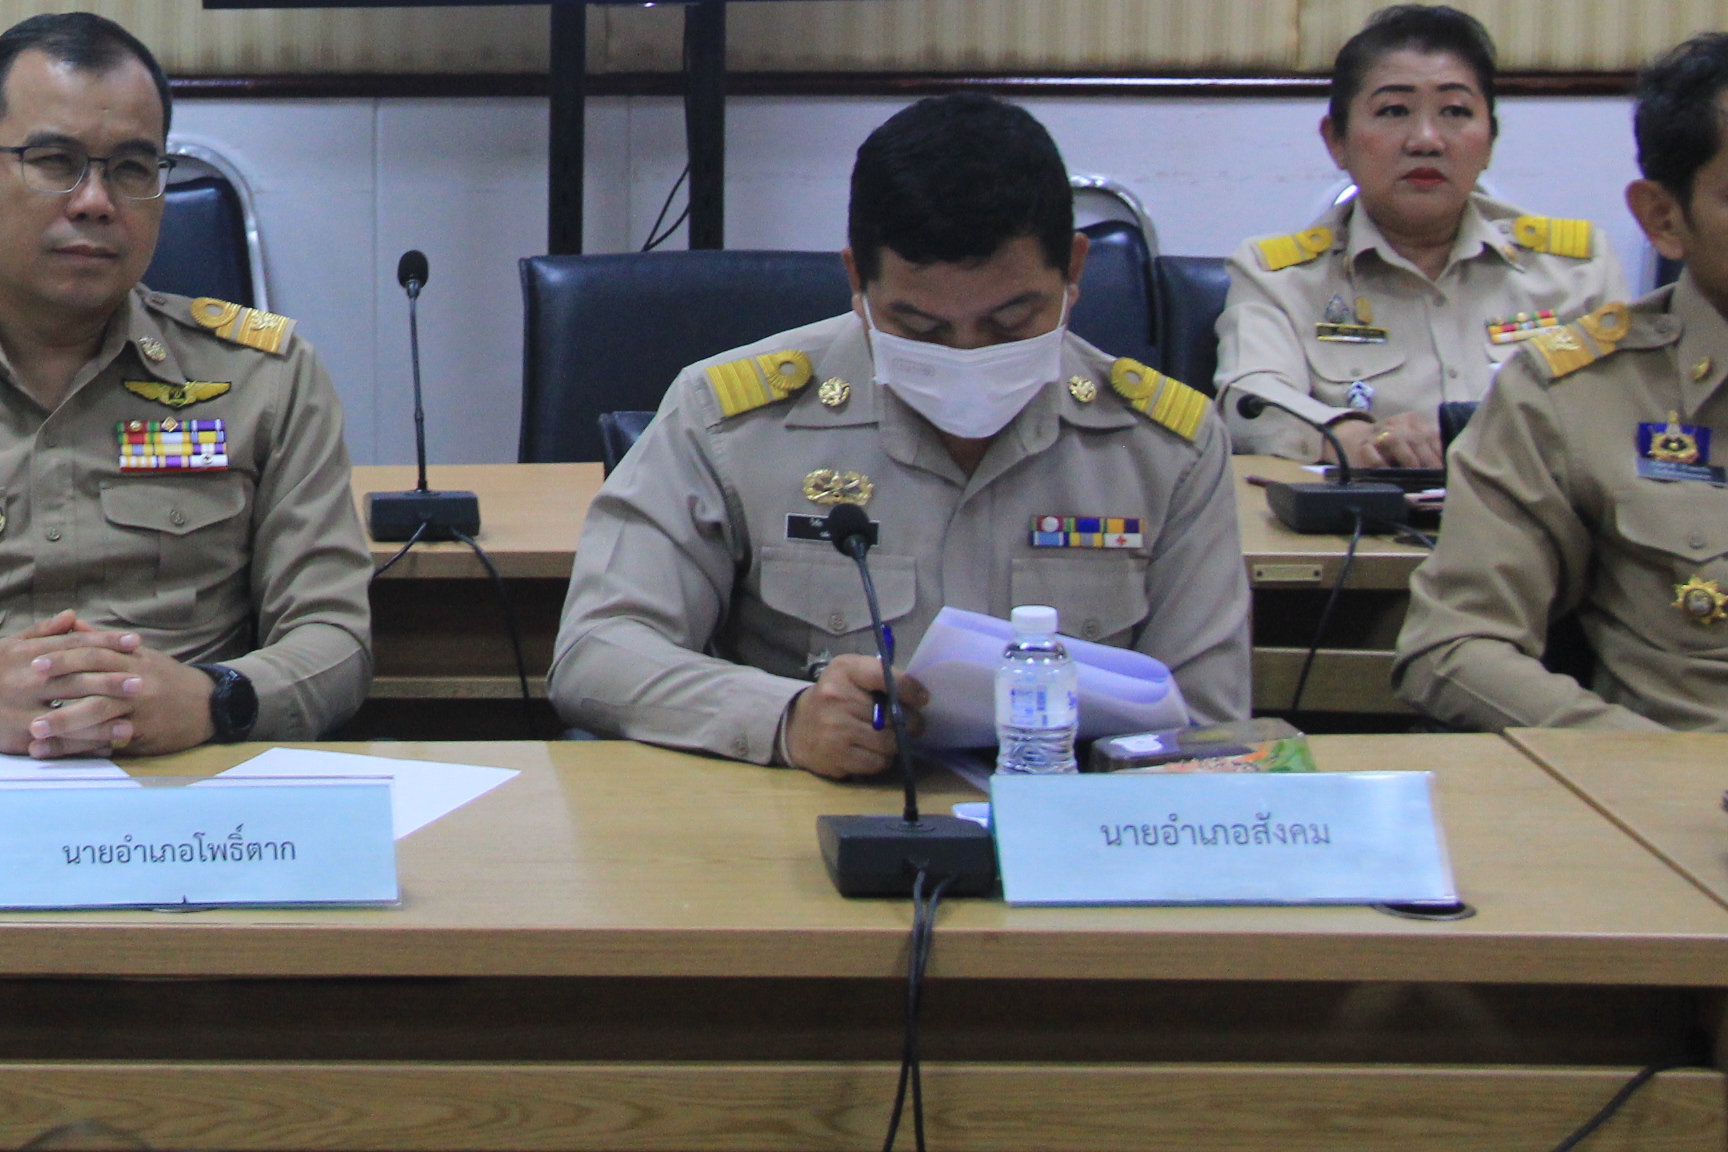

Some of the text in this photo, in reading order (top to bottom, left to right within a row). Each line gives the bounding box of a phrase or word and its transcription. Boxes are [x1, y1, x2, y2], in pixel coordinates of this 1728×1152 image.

[62, 824, 297, 865] นายอำเภอโพธิ์ตาก
[1100, 812, 1331, 846] นายอำเภอสังคม
